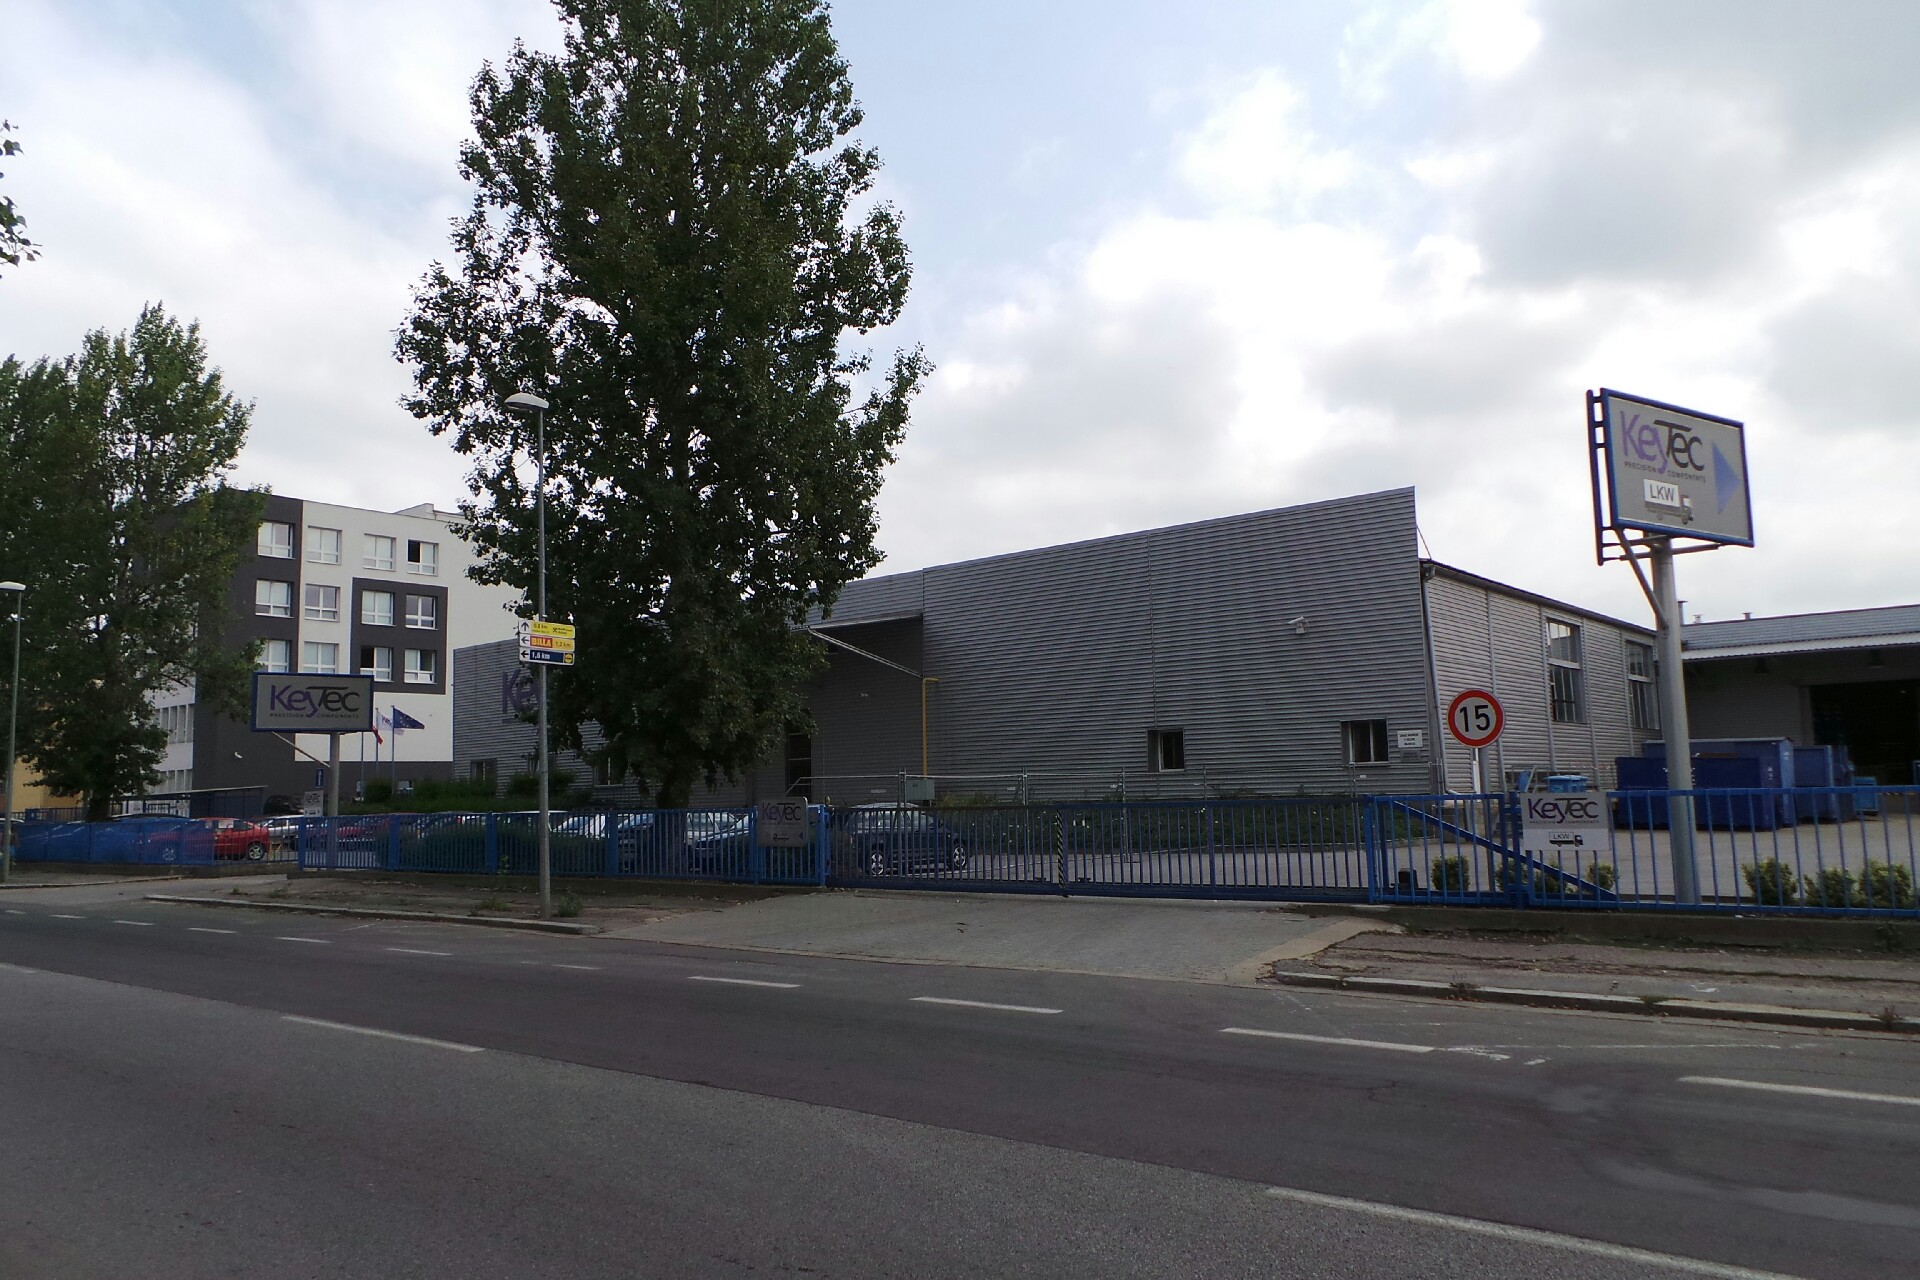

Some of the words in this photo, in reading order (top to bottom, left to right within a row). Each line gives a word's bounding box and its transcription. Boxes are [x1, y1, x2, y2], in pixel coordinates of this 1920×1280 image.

[1620, 410, 1705, 475] KeyTec
[1624, 461, 1657, 473] PRECISION
[1650, 483, 1675, 502] LKW
[531, 637, 552, 647] BILLA
[541, 652, 551, 660] km
[269, 685, 360, 718] KeyTec
[1459, 705, 1491, 732] 15
[1527, 798, 1599, 824] KeyTec
